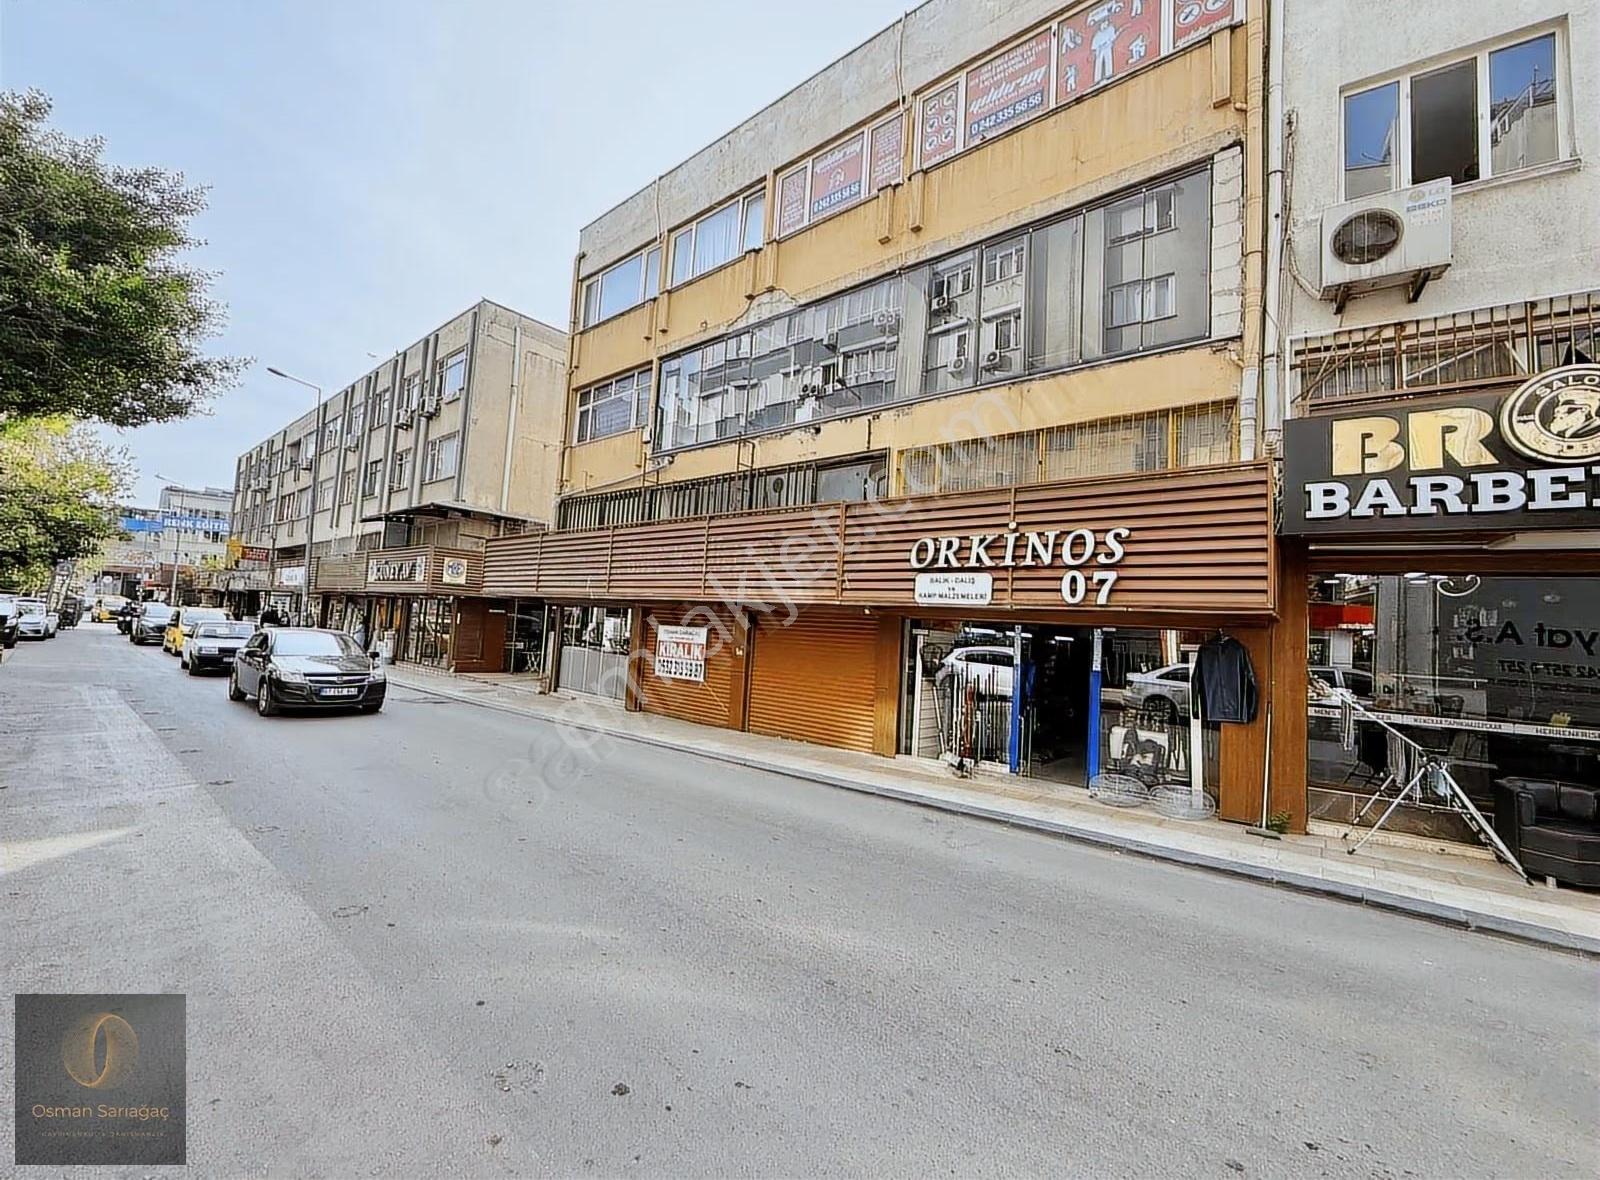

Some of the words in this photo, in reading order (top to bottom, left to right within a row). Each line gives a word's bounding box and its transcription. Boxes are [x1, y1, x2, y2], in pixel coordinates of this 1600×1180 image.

[971, 122, 979, 134] 0
[1535, 375, 1600, 398] SALO
[1304, 467, 1600, 520] BARBE
[910, 521, 1131, 568] ORKİNOS
[1060, 570, 1118, 605] 07
[659, 641, 704, 660] KIRALIK
